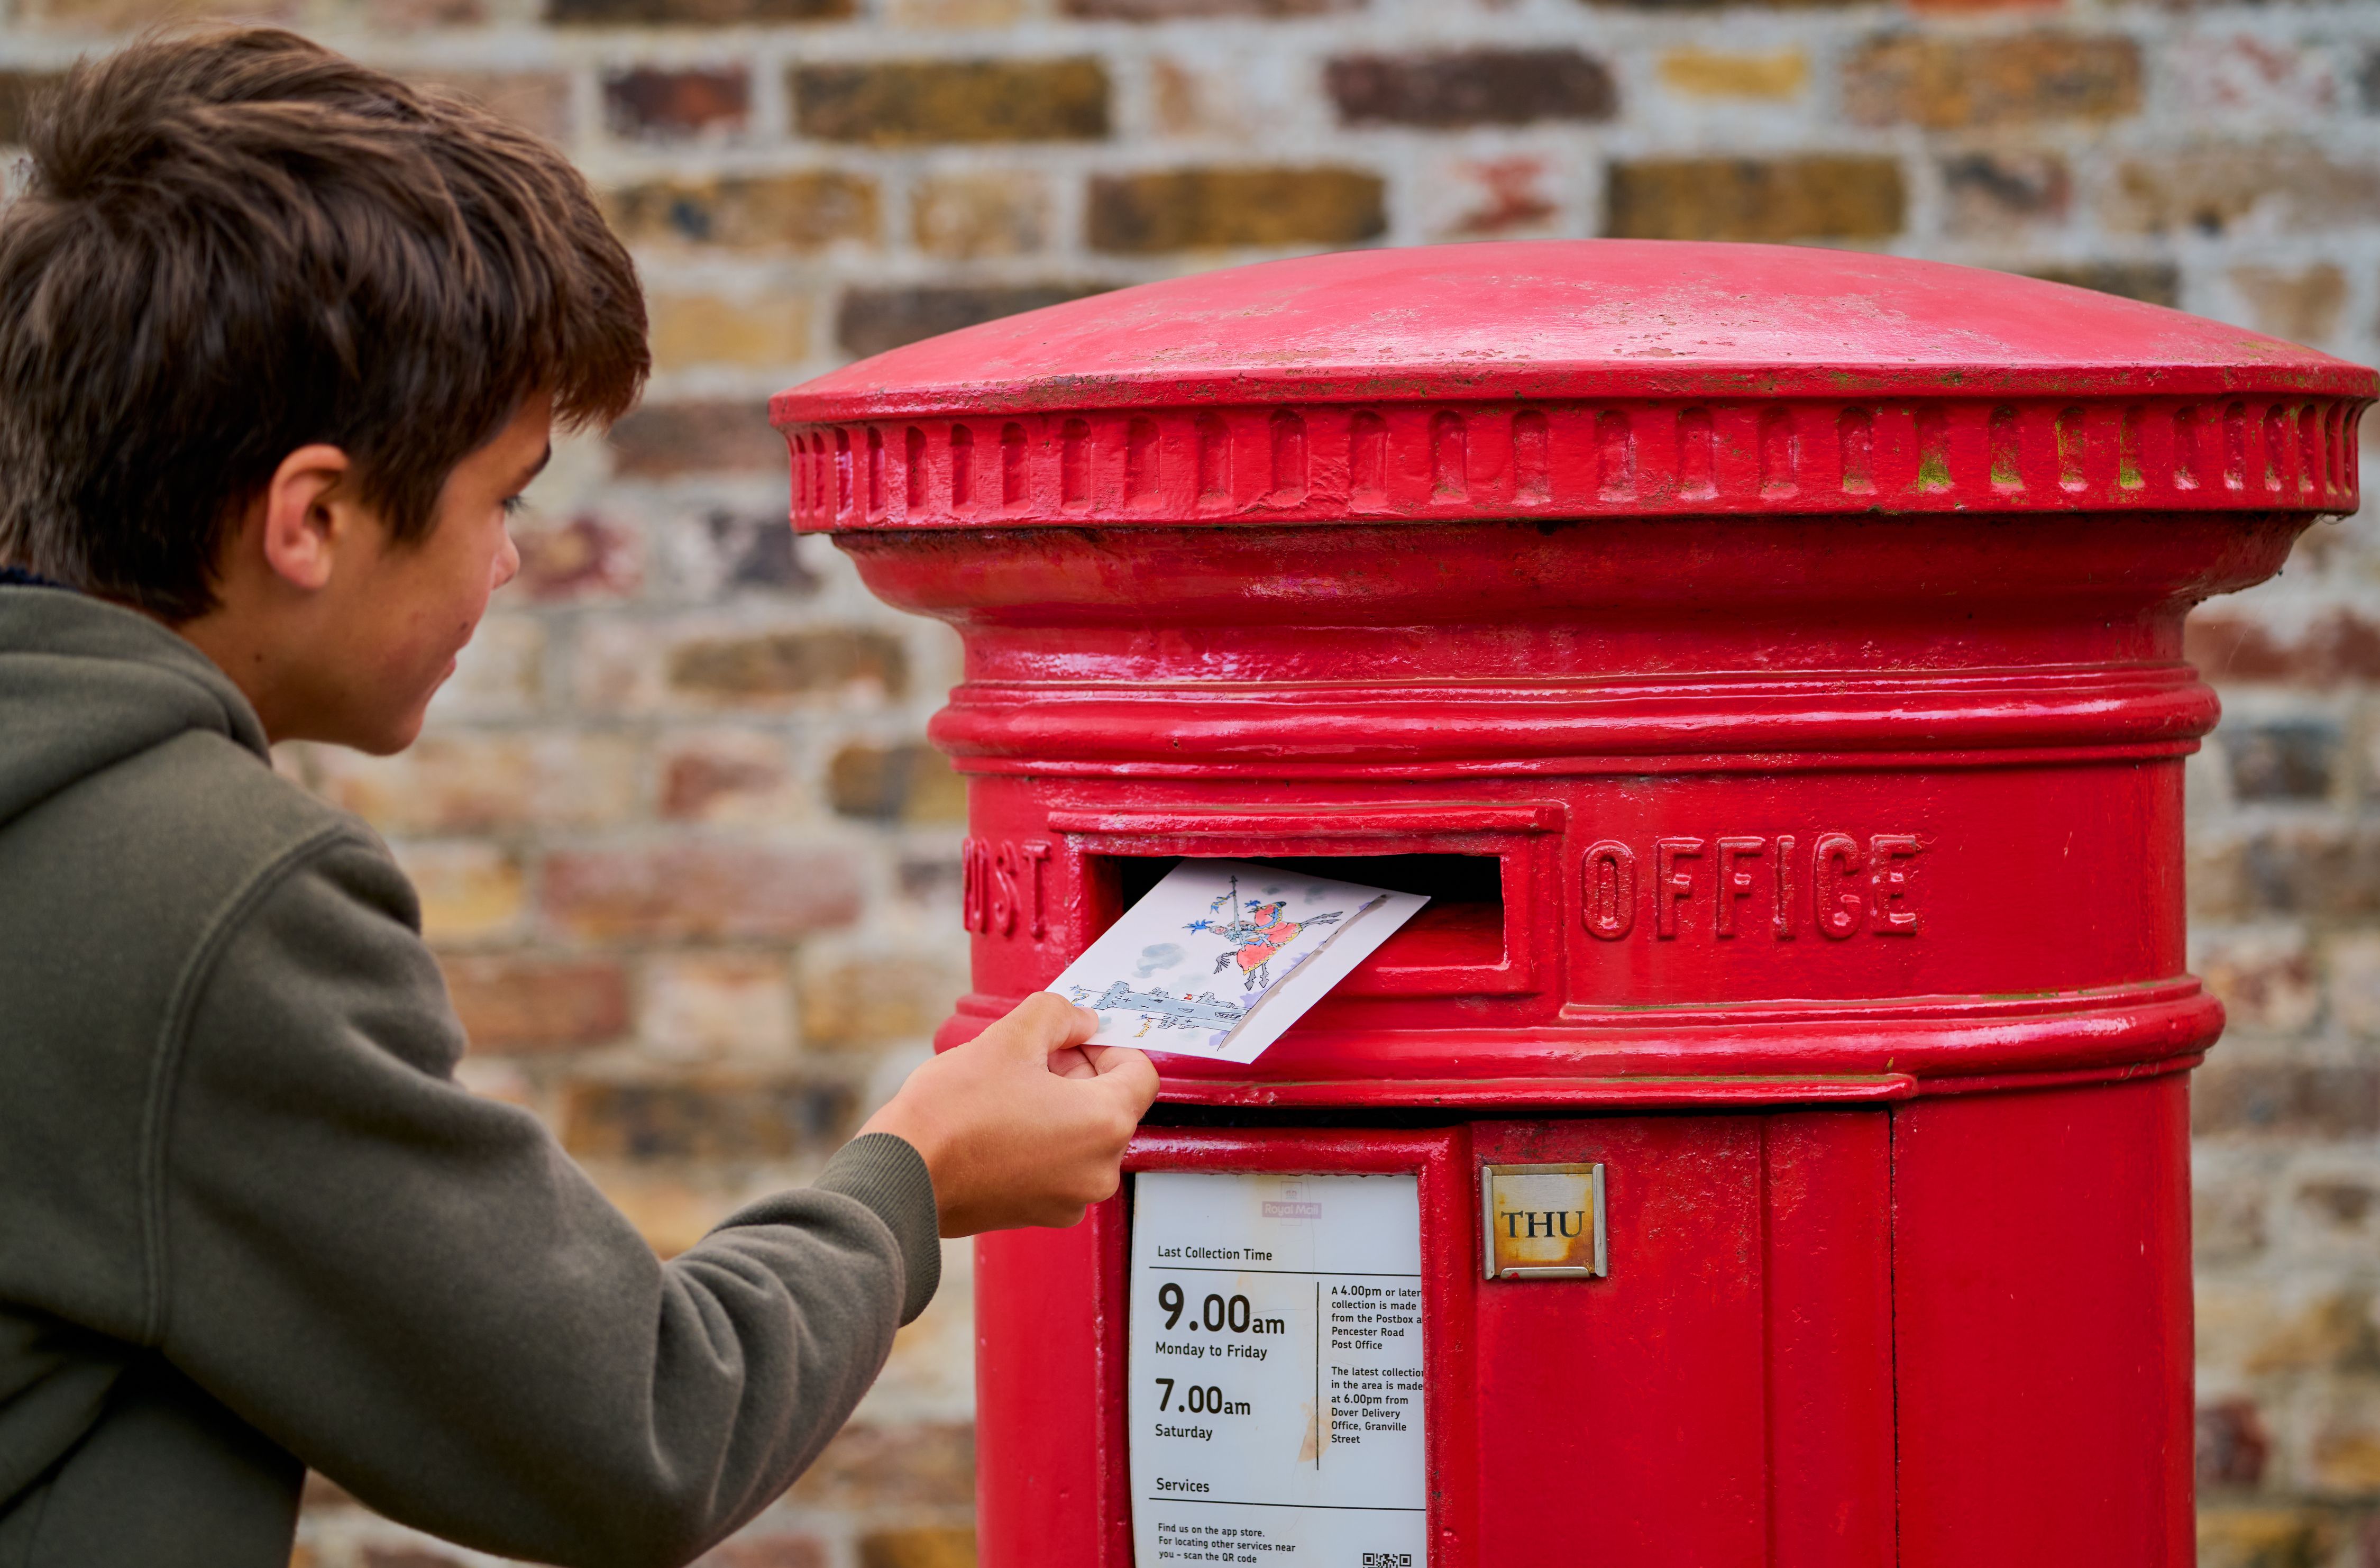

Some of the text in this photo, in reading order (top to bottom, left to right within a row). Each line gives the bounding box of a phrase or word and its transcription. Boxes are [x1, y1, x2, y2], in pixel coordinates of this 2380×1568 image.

[1580, 832, 1918, 940] OFFICE
[1265, 1204, 1318, 1216] Royal Mail
[1500, 1210, 1585, 1238] THU
[1158, 1245, 1273, 1261] Last Collection Time
[1331, 1286, 1338, 1295] A
[1340, 1285, 1382, 1298] 4.00pm
[1398, 1288, 1422, 1297] later
[1158, 1282, 1285, 1335] 9.00am
[1331, 1300, 1417, 1310] collection is made
[1331, 1312, 1354, 1323] from
[1357, 1314, 1372, 1323] the
[1376, 1314, 1413, 1324] Postbox
[1332, 1326, 1405, 1337] Pencester Road
[1332, 1339, 1383, 1350] Post Office
[1156, 1341, 1268, 1362] Monday to Friday
[1331, 1366, 1349, 1376] The
[1352, 1366, 1379, 1376] latest
[1331, 1379, 1340, 1389] in
[1343, 1380, 1359, 1389] the
[1386, 1380, 1394, 1390] is
[1397, 1381, 1423, 1390] made
[1155, 1378, 1251, 1416] 7.00am
[1331, 1393, 1408, 1406] at 6.00pm from
[1331, 1407, 1400, 1420] Dover Delivery
[1155, 1423, 1213, 1442] Saturday
[1331, 1420, 1407, 1432] Office, Granville
[1331, 1434, 1361, 1444] Street
[1156, 1477, 1210, 1493] Services
[1158, 1523, 1176, 1533] Find
[1204, 1526, 1219, 1535] the
[1221, 1528, 1238, 1538] app
[1240, 1528, 1265, 1537] store.
[1158, 1536, 1173, 1545] For
[1175, 1537, 1209, 1549] locating
[1211, 1539, 1235, 1549] other
[1237, 1541, 1273, 1551] services
[1159, 1551, 1174, 1560] you
[1205, 1552, 1219, 1561] the
[1222, 1552, 1234, 1562] QR
[1237, 1554, 1257, 1563] code
